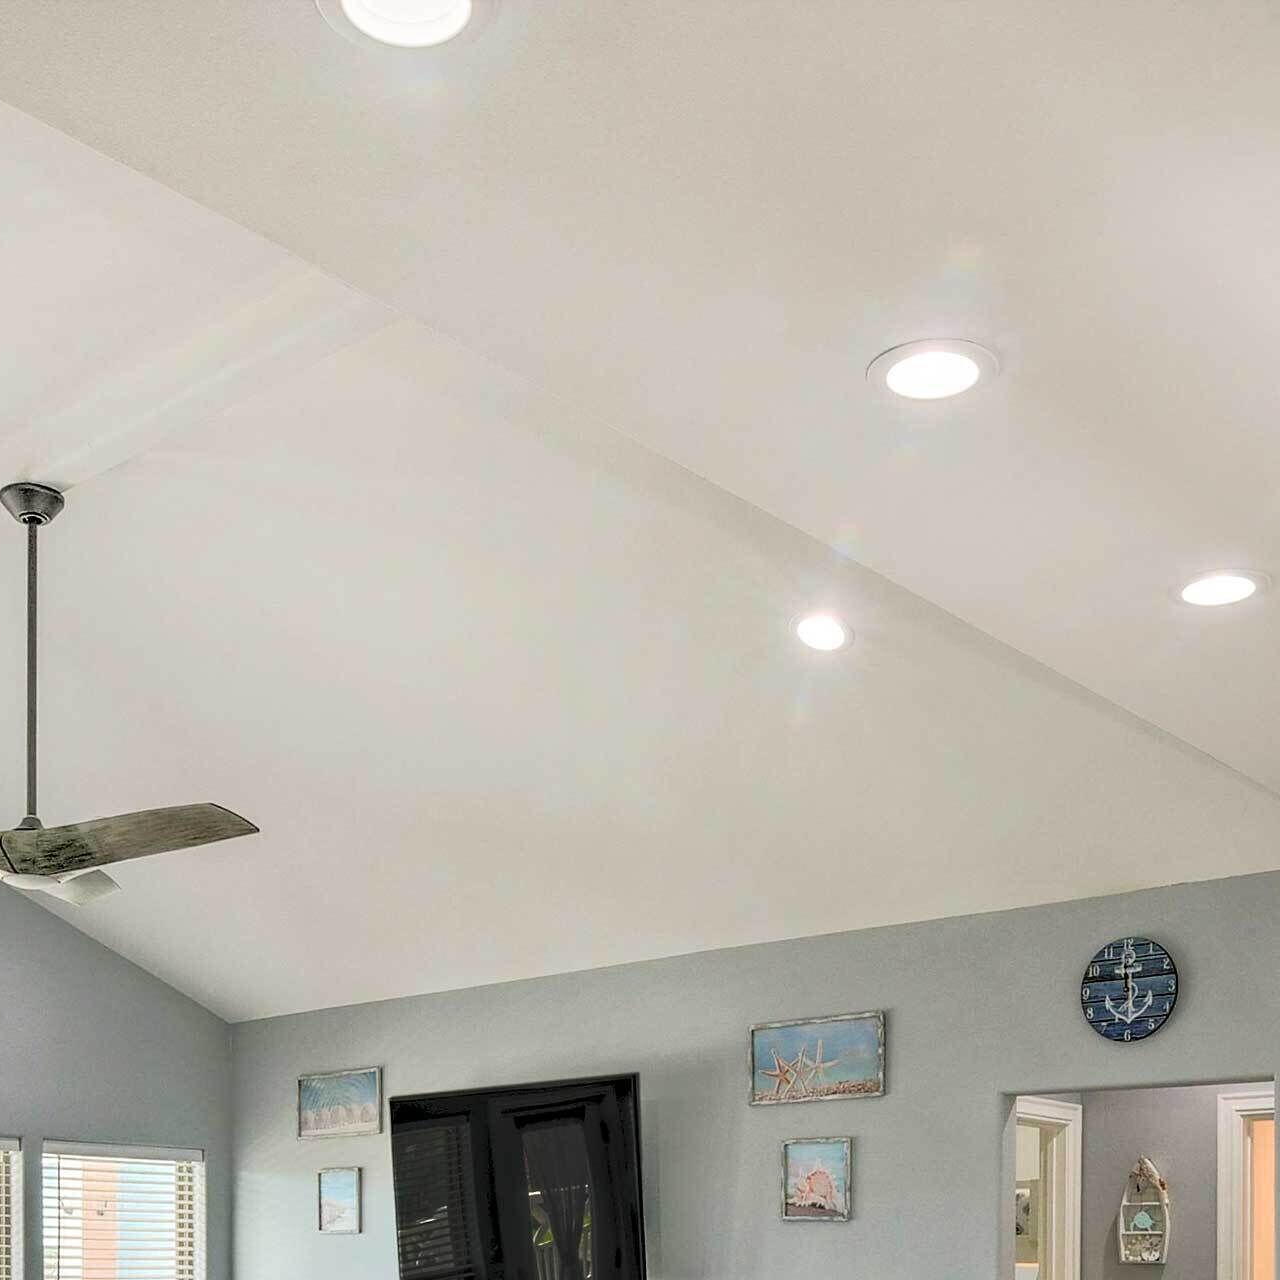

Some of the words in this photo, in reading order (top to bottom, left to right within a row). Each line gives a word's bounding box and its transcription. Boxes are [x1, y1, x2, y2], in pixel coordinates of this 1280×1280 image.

[1124, 938, 1134, 950] 12
[1104, 946, 1113, 959] 11
[1163, 958, 1170, 969] 2
[1089, 965, 1100, 977] 10
[1168, 980, 1175, 992] 3
[1082, 987, 1090, 1000] 9
[1086, 1007, 1094, 1019] 8
[1101, 1022, 1108, 1034] 7
[1148, 1018, 1155, 1030] 5
[1124, 1029, 1131, 1041] 6
